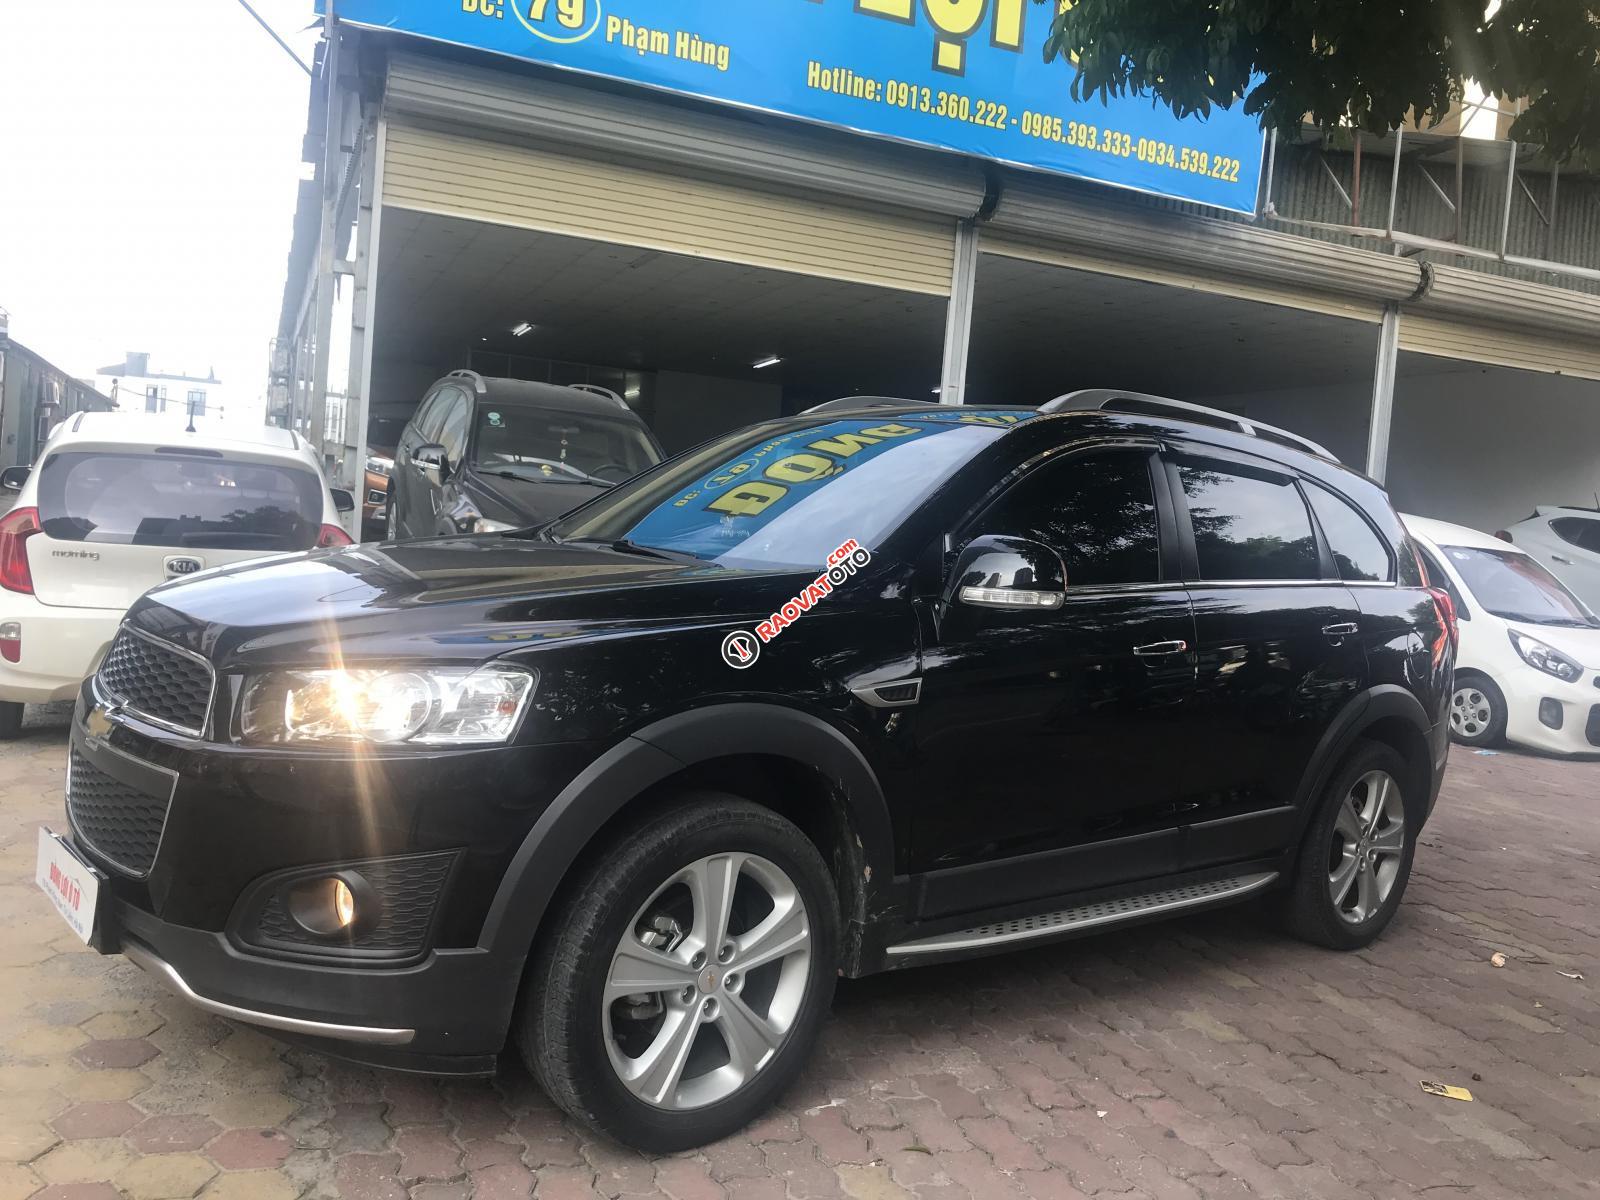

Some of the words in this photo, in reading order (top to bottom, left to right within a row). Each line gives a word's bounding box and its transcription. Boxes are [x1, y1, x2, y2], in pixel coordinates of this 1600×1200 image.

[606, 15, 669, 56] Phạm
[676, 33, 730, 71] Hùng
[808, 60, 882, 102] Hotline:
[886, 79, 1007, 131] 0913.360.222
[52, 550, 100, 561] morning
